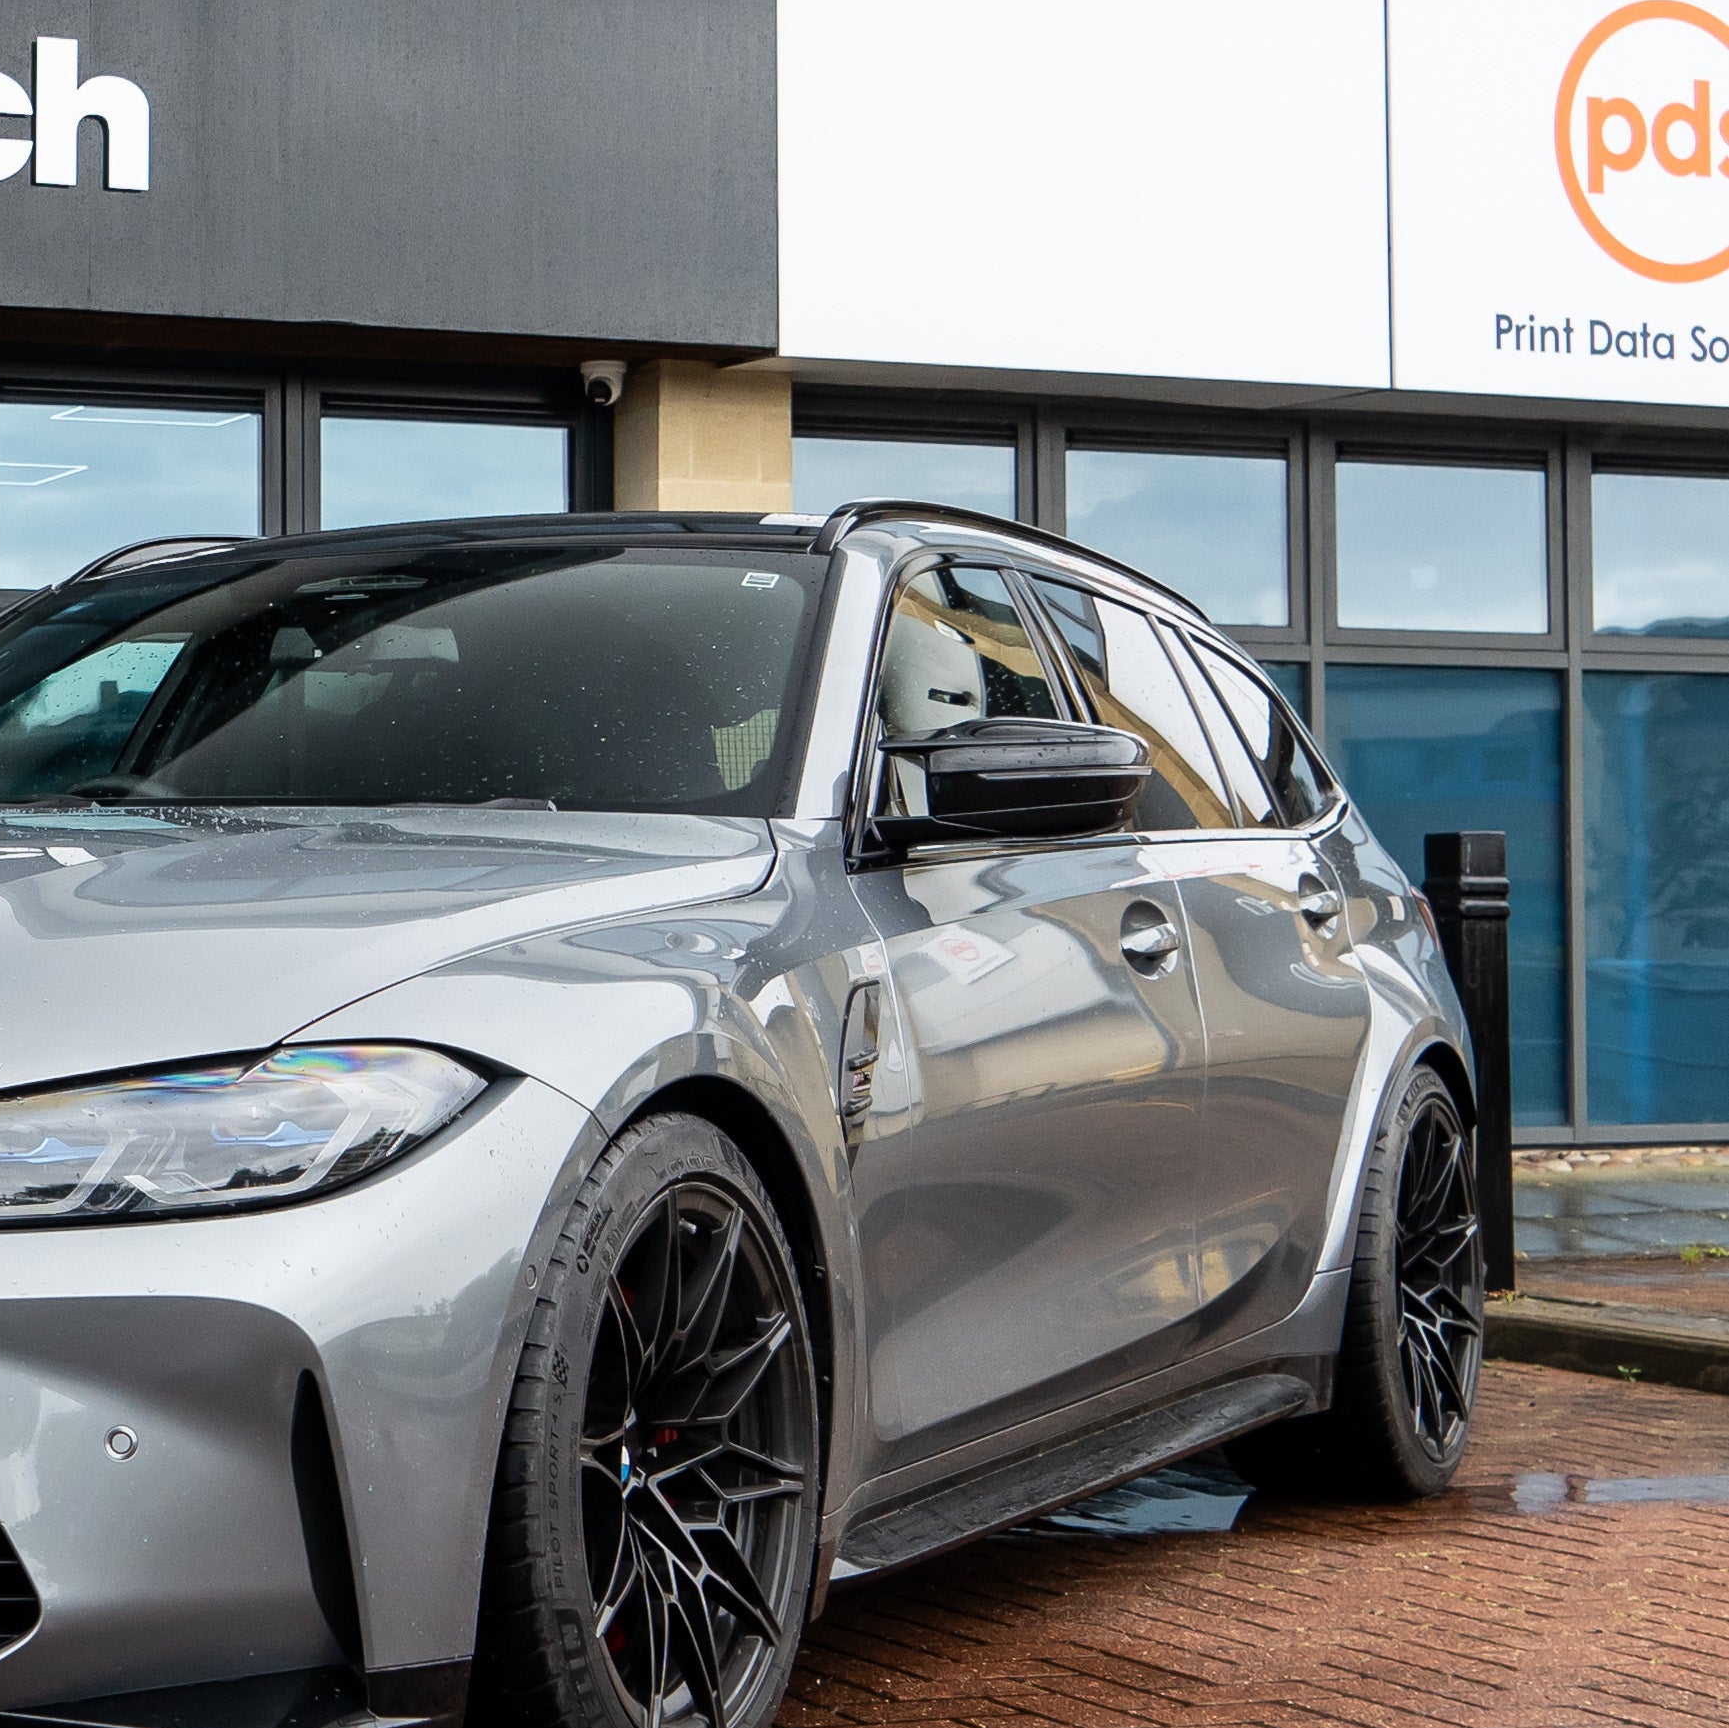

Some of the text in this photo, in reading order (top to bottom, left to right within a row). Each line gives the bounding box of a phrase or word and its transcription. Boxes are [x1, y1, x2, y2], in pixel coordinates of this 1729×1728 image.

[1586, 79, 1729, 194] pd
[1495, 313, 1574, 354] Print
[1589, 319, 1675, 360] Data
[548, 1426, 561, 1512] SPORT
[548, 1521, 565, 1588] PILOT
